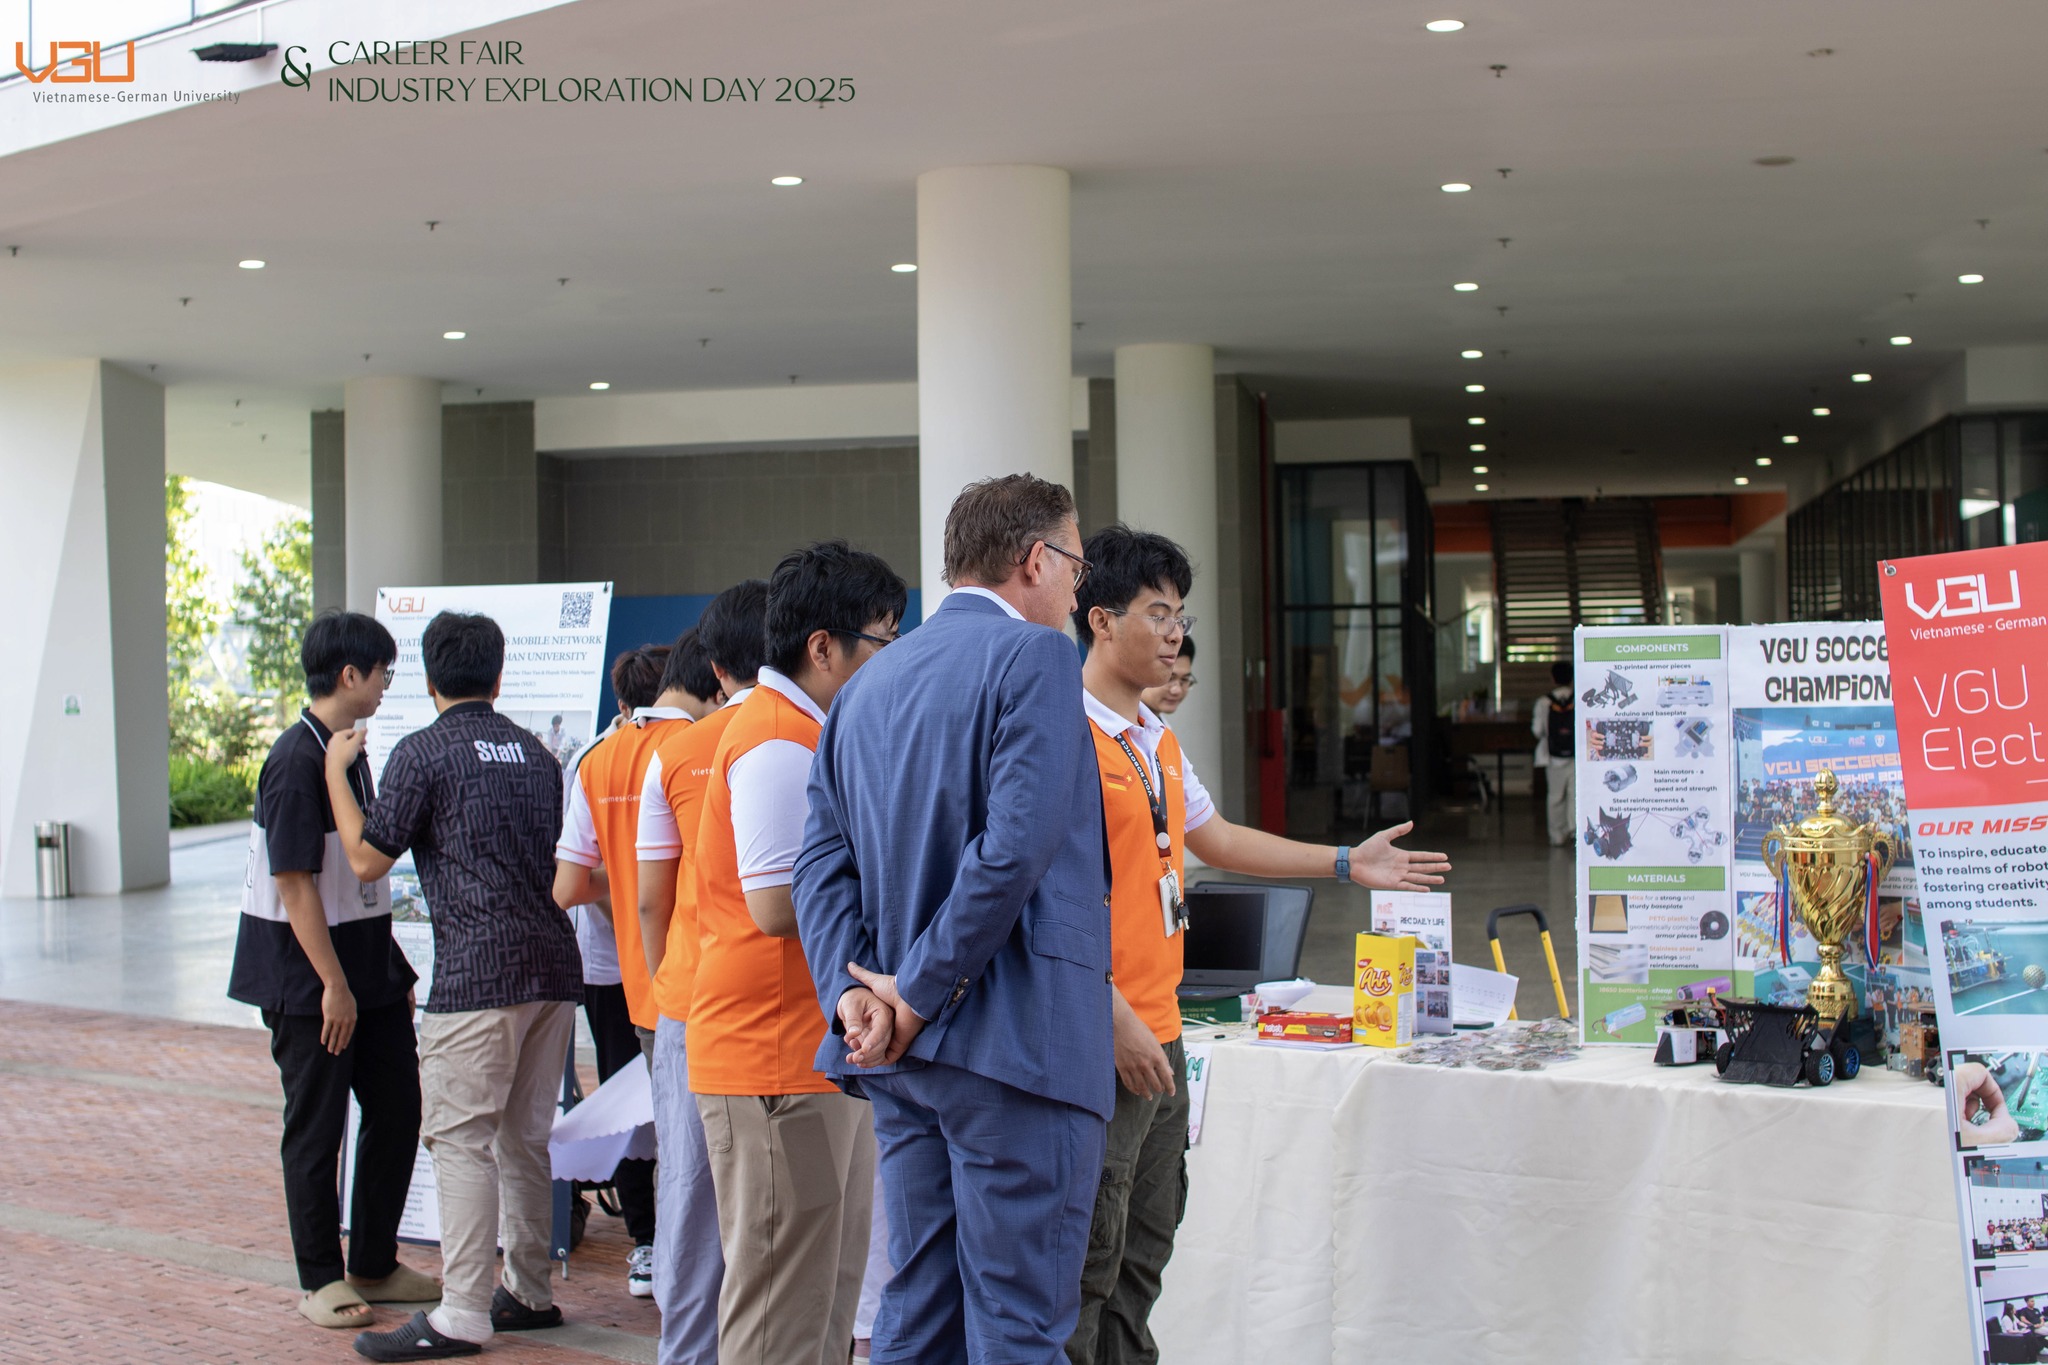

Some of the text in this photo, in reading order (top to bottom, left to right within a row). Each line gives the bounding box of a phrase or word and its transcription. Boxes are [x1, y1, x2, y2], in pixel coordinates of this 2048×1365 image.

[1905, 569, 2021, 620] VGU
[388, 597, 425, 613] VGU
[1910, 622, 1985, 641] Vietnamese
[1995, 616, 2047, 631] German
[511, 636, 550, 645] MOBILE
[552, 635, 603, 645] NETWORK
[1615, 643, 1689, 654] COMPONENTS
[1759, 637, 1808, 664] VGU
[400, 653, 419, 663] THE
[527, 651, 587, 661] UNIVERSITY
[1913, 664, 2029, 718] VGU
[473, 739, 526, 764] Staff
[1120, 740, 1144, 777] ROBOTICS
[1764, 760, 1801, 776] VGU
[1143, 778, 1152, 796] VGU
[1917, 821, 1974, 837] OUR
[1918, 848, 1935, 859] To
[1938, 847, 1988, 860] inspire,
[1921, 866, 1943, 876] the
[1946, 865, 1991, 875] realms
[1994, 864, 2009, 874] of
[1628, 874, 1686, 883] MATERIALS
[1923, 882, 1985, 894] fostering
[1926, 897, 2038, 910] among students.
